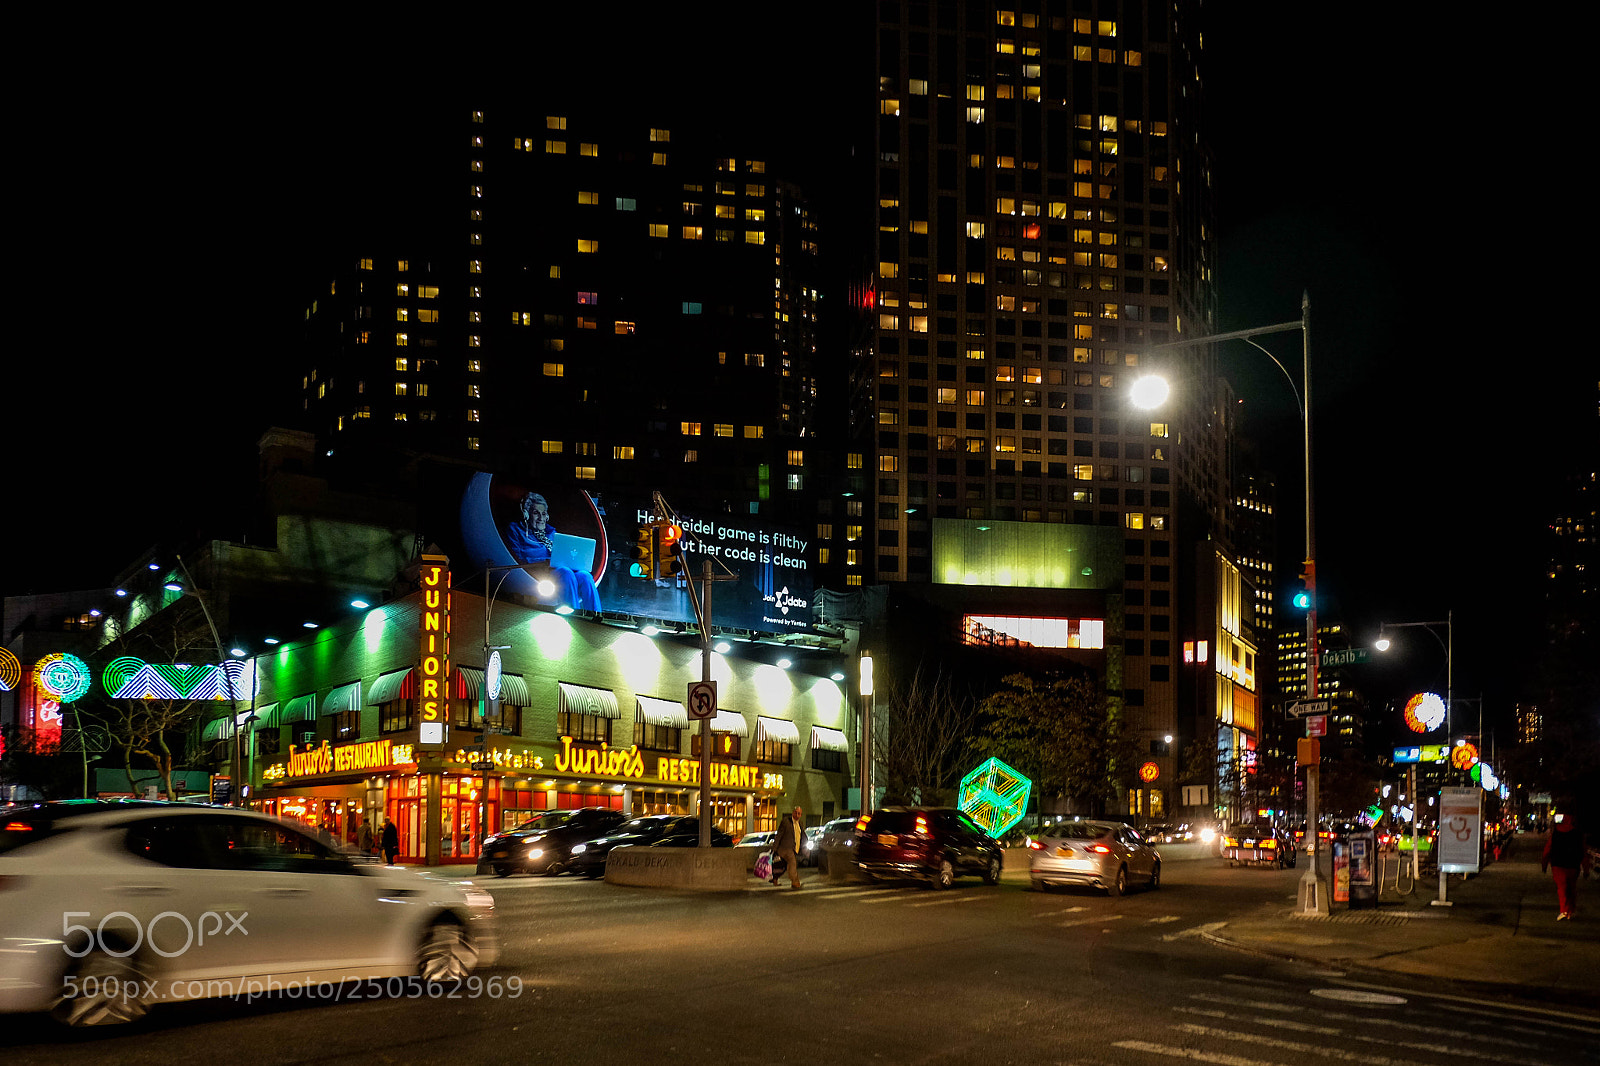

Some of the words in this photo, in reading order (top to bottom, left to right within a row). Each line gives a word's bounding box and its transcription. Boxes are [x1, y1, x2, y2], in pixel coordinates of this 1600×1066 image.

[669, 515, 714, 535] dreidel
[718, 527, 755, 542] game
[759, 530, 769, 544] is
[773, 533, 808, 553] filthy
[698, 540, 722, 556] her
[724, 547, 756, 561] code
[759, 550, 770, 564] is
[773, 553, 807, 569] clean
[424, 566, 442, 721] JUNIORS
[1322, 651, 1355, 666] Dekalb
[1293, 705, 1308, 714] ONE
[1311, 702, 1325, 712] WAY
[287, 739, 332, 778] Junior's
[334, 739, 391, 772] RESTAURANT
[455, 746, 544, 770] Cocktails
[554, 735, 645, 779] Junior's
[658, 757, 759, 788] RESTURANT
